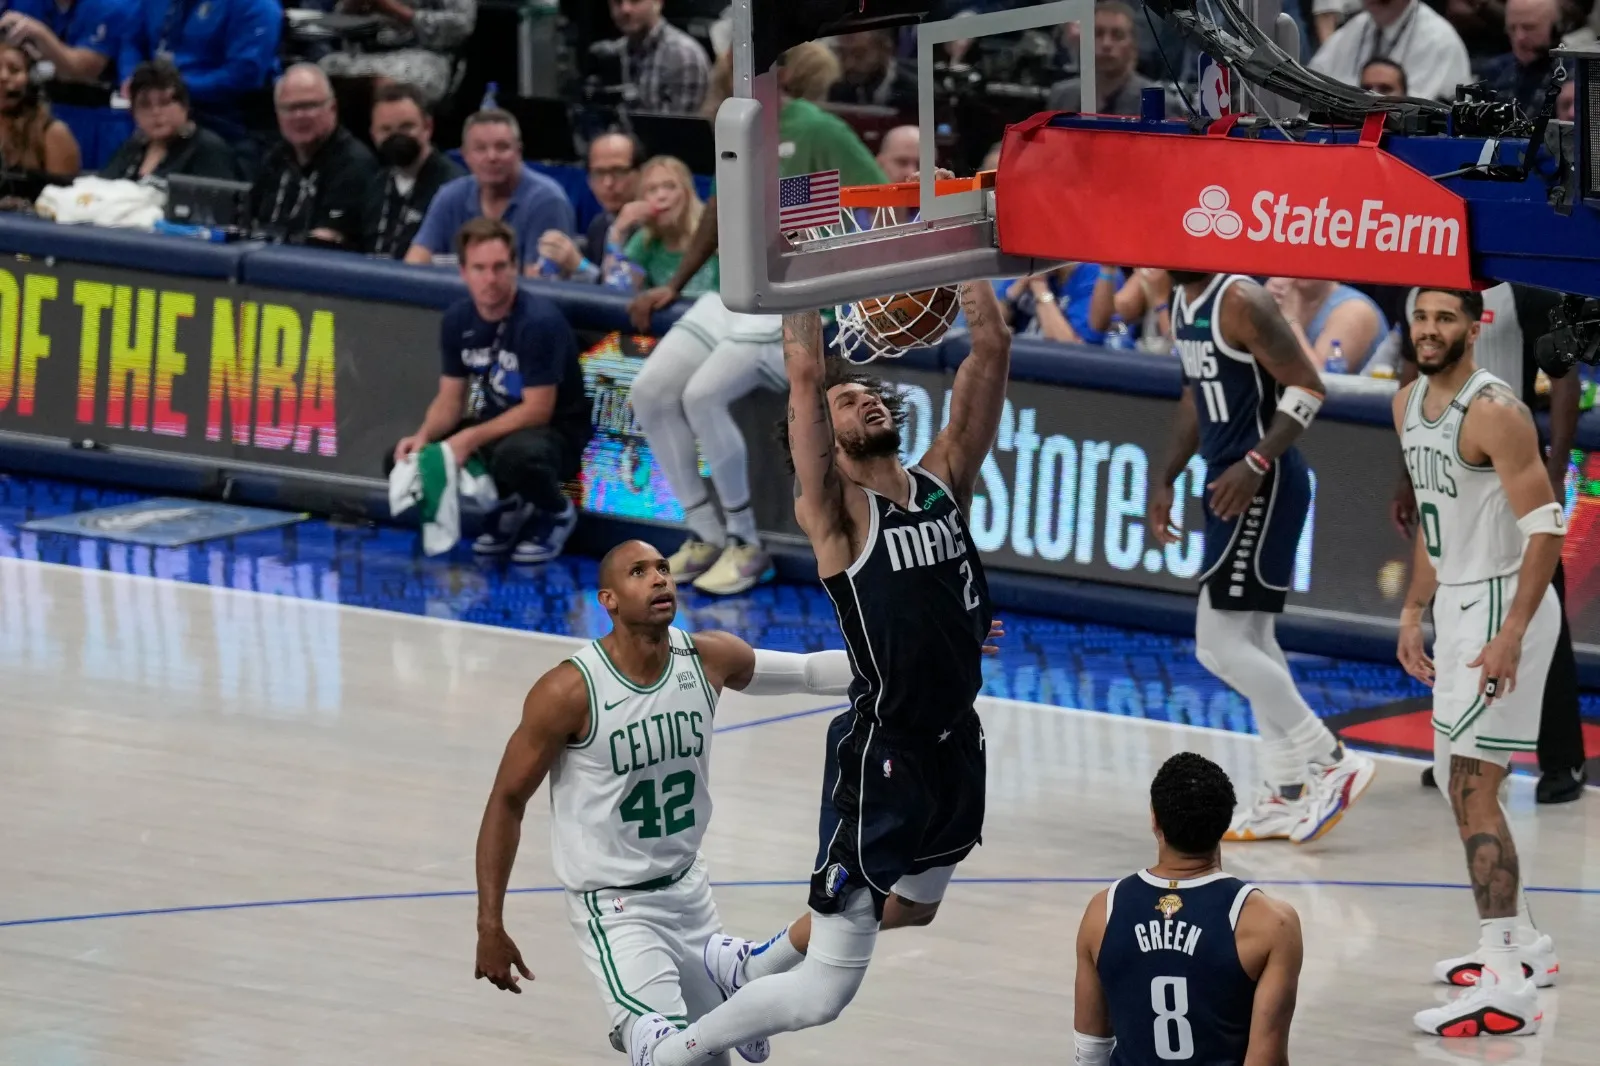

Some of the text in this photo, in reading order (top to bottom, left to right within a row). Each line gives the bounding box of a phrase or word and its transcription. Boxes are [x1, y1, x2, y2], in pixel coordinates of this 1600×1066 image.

[73, 279, 195, 437] THE
[205, 297, 337, 457] NBA
[1200, 381, 1229, 423] 11
[1421, 501, 1441, 557] 0
[959, 560, 980, 611] 2
[676, 671, 695, 683] VISTA
[679, 681, 697, 691] PRINT
[610, 711, 704, 777] CELTICS
[619, 769, 696, 839] 42
[1134, 919, 1203, 956] GREEN
[1150, 976, 1194, 1060] 8
